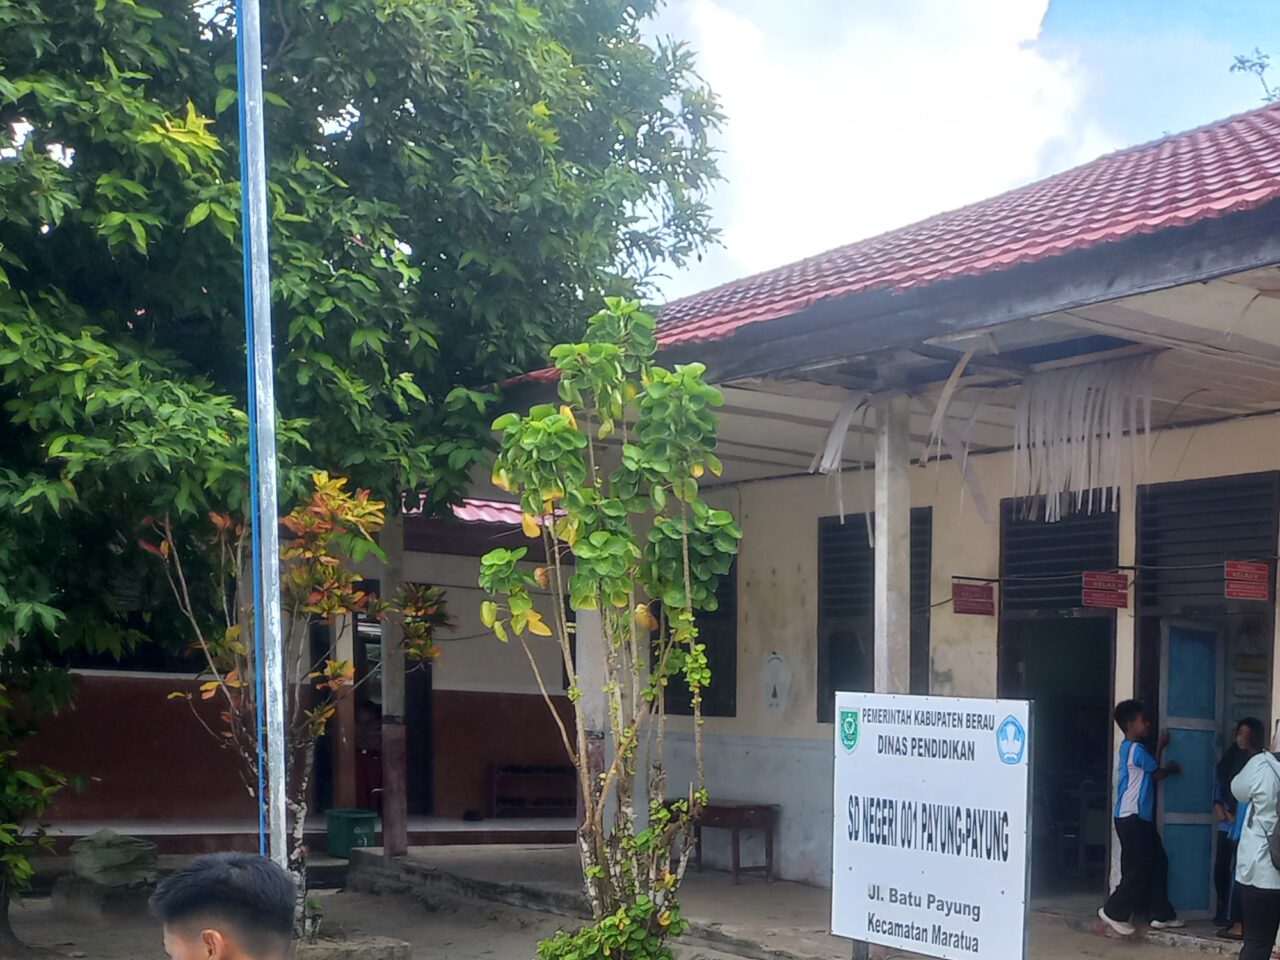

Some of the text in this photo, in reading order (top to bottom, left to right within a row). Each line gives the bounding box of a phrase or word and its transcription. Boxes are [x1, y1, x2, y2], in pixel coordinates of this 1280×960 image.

[862, 708, 995, 730] PEMERINTAH KABUPATEN BERAU
[877, 734, 975, 761] DINAS PENDIDIKAN
[848, 794, 1009, 862] SD NEGERI 001 PAYUNG-PAYUNG
[889, 887, 922, 908] Batu
[927, 893, 981, 922] Payung
[867, 912, 979, 953] Kecamatan Maratua
